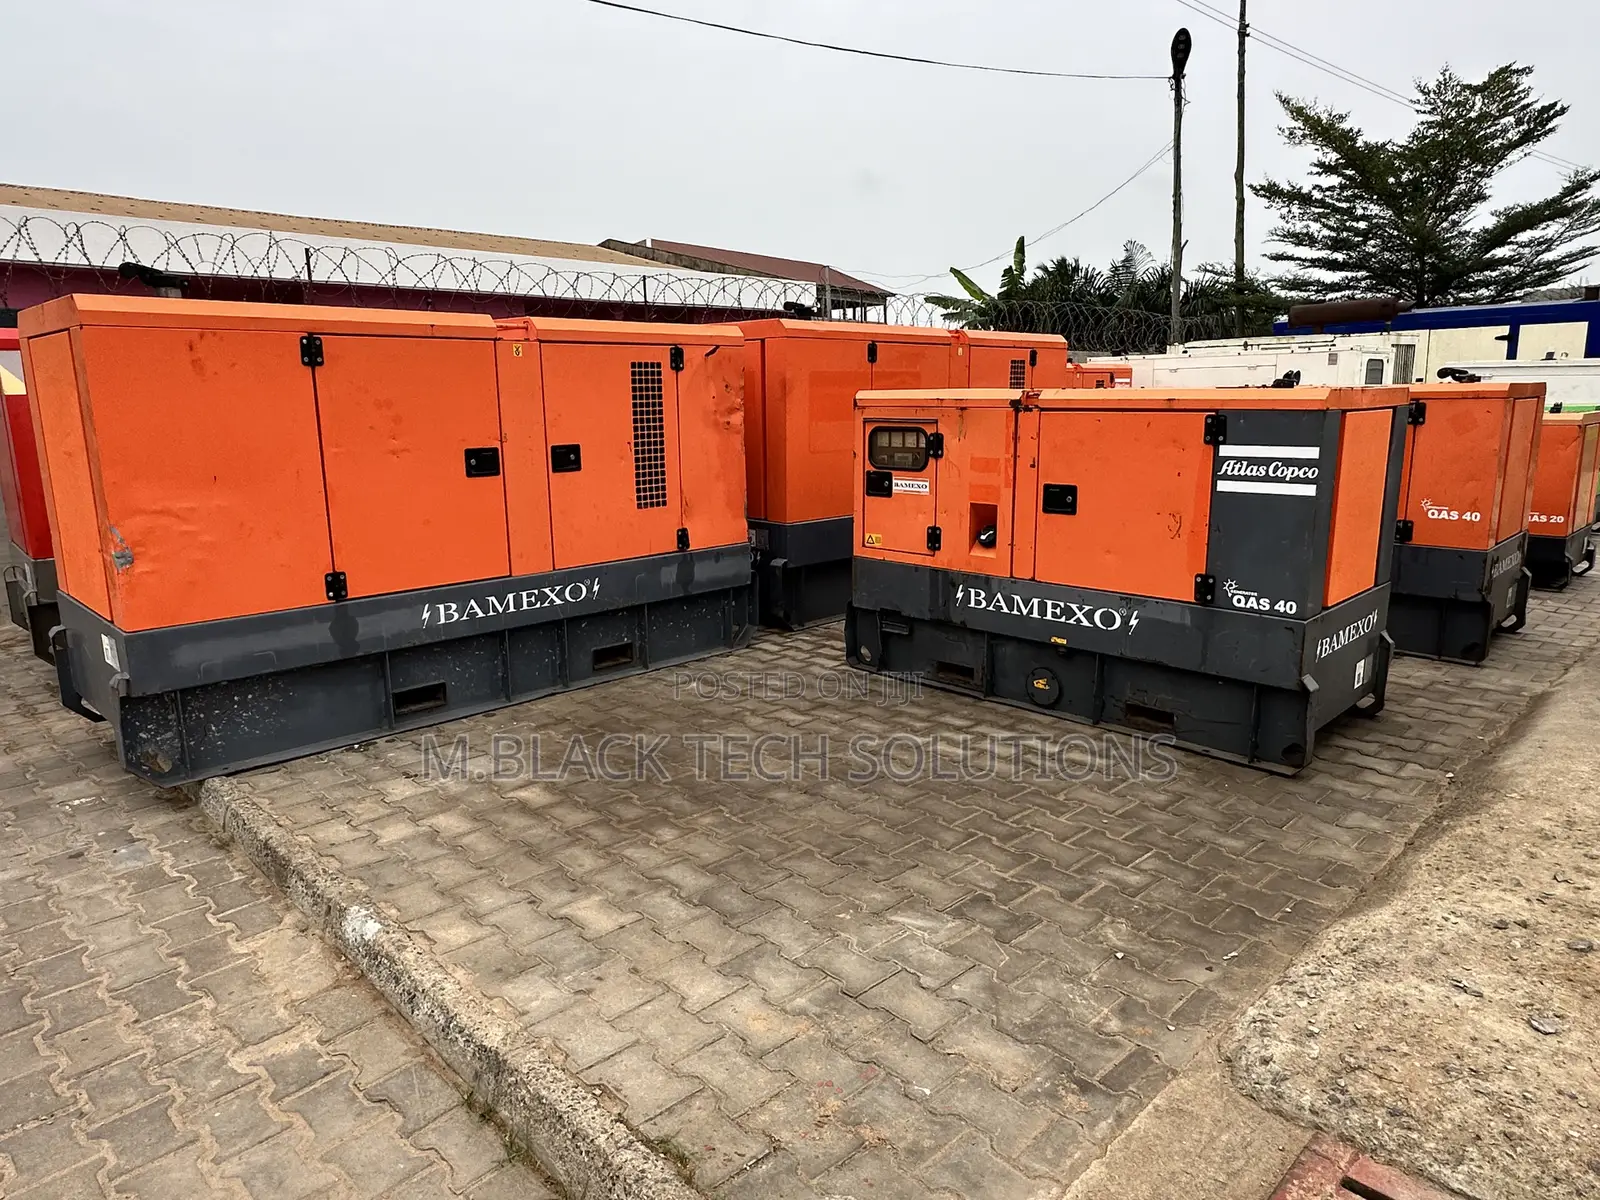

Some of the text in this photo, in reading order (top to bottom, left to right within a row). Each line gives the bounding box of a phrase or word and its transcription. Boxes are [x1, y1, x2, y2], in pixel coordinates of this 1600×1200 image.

[1217, 460, 1319, 481] Atlas Copco
[893, 482, 928, 490] BAMEXO
[1427, 509, 1481, 522] QAS 40
[1549, 515, 1565, 523] 20
[436, 582, 587, 625] BAMEXO
[967, 588, 1122, 631] BAMEXO
[1232, 594, 1297, 615] QAS 40
[1320, 614, 1374, 659] BAMEXO
